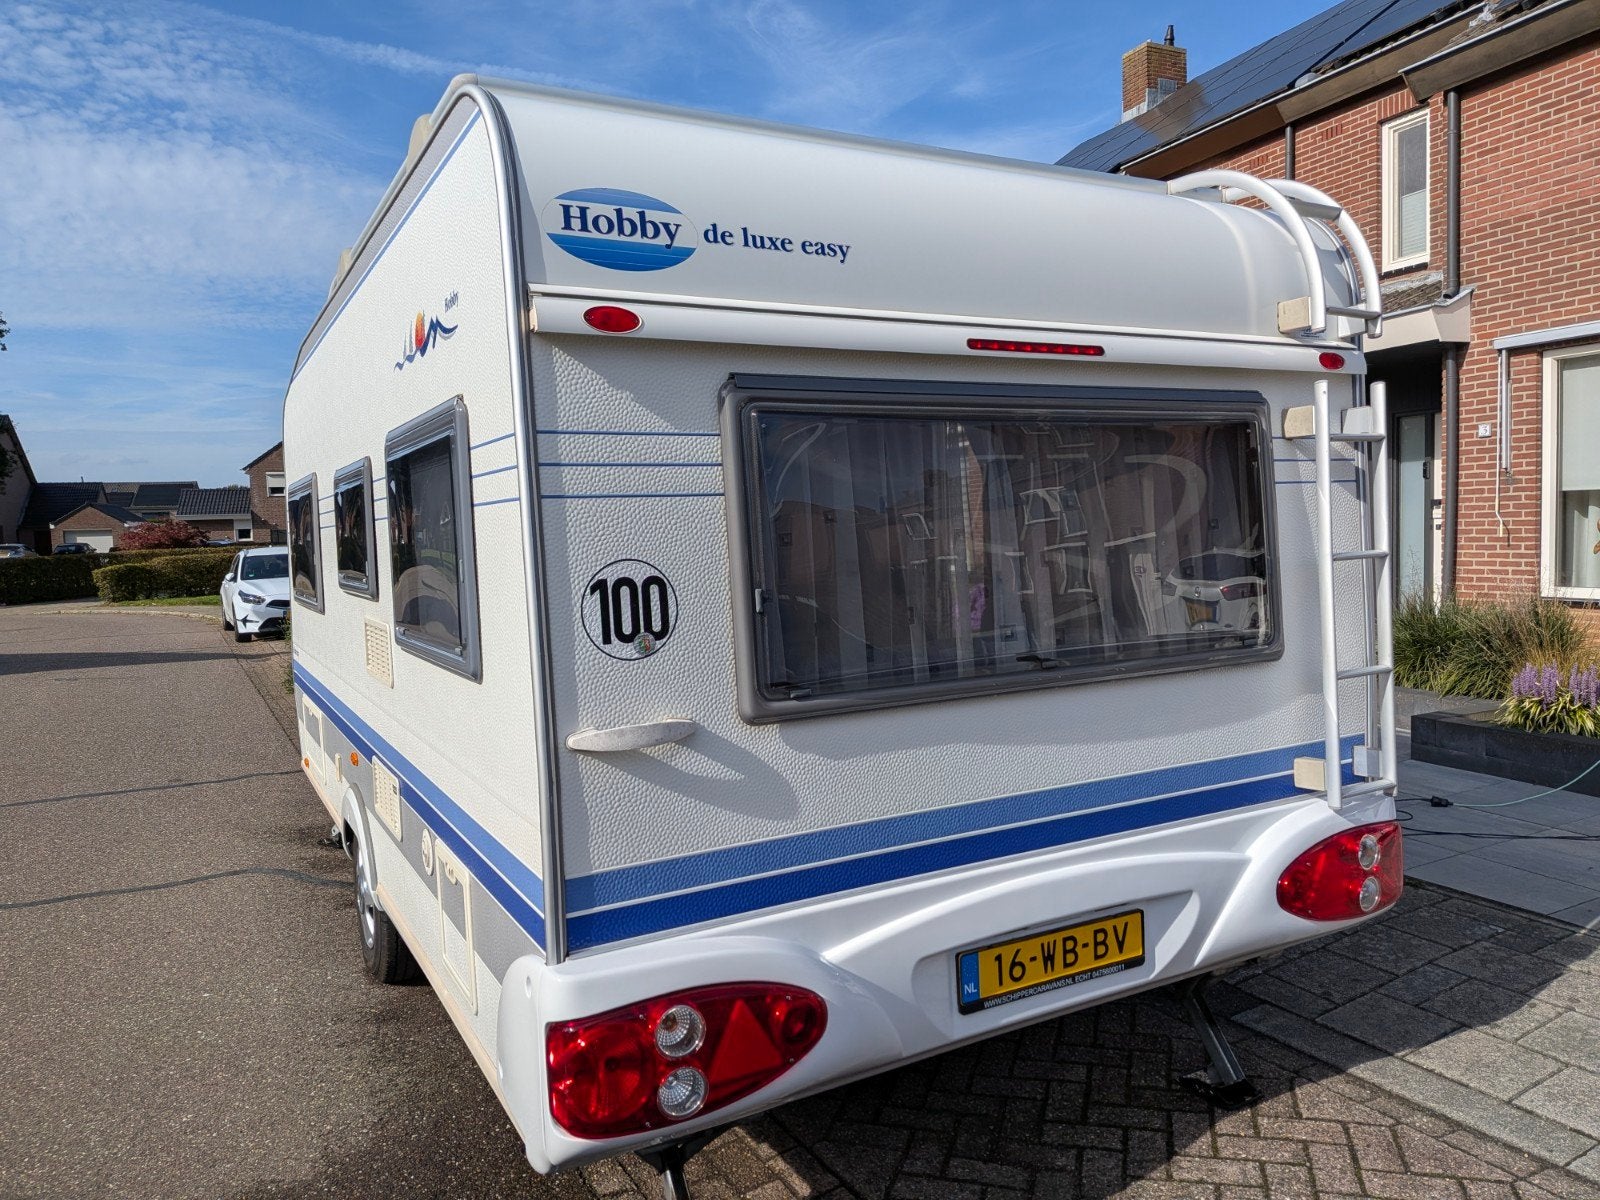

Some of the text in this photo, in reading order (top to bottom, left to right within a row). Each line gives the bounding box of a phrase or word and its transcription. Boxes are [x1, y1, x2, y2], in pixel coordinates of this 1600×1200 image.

[558, 203, 682, 249] Hobby
[703, 223, 850, 263] de luxe easy
[590, 575, 670, 645] 100
[994, 922, 1129, 987] 16-WB-BV
[964, 982, 978, 995] NL
[1075, 972, 1092, 984] ECHT
